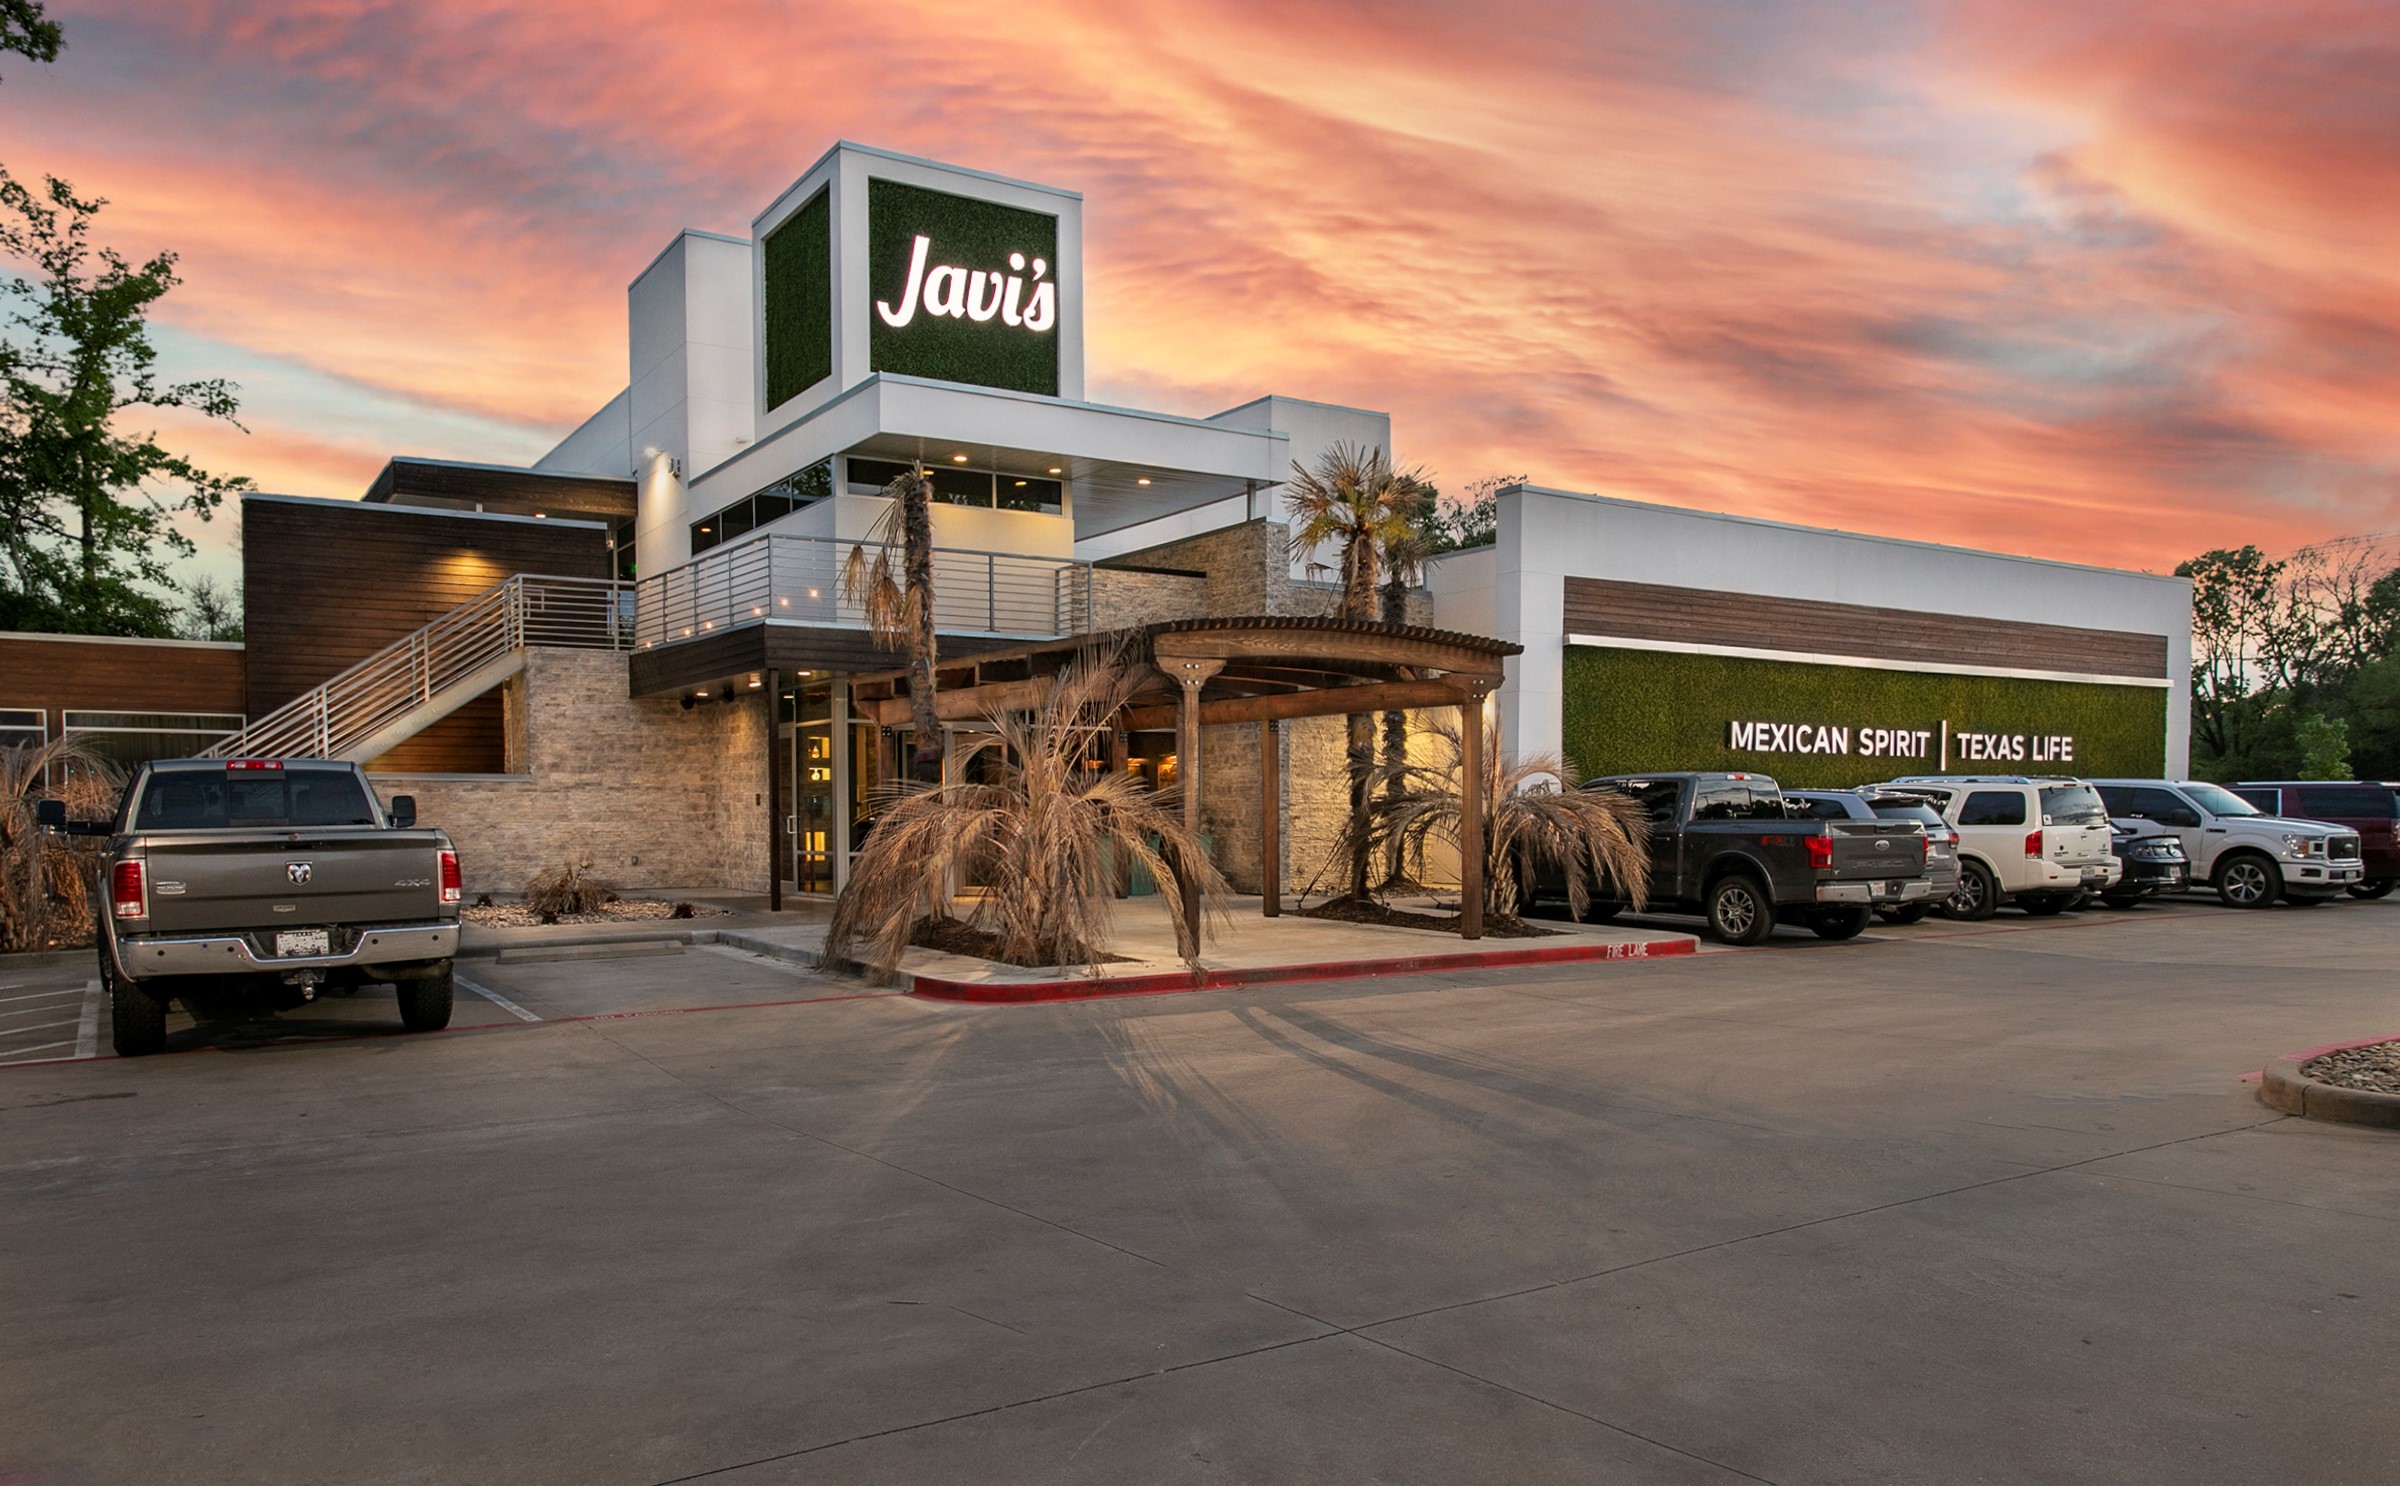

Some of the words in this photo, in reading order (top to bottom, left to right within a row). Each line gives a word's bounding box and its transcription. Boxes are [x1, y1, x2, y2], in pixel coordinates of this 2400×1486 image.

[876, 235, 1055, 332] Javi's
[1730, 720, 1848, 755] MEXICAN
[1858, 727, 1931, 758] SPIRIT
[1957, 732, 2024, 761] TEXAS
[2033, 735, 2073, 762] LIFE
[1606, 944, 1624, 958] FIRE
[1628, 942, 1648, 956] LANE
